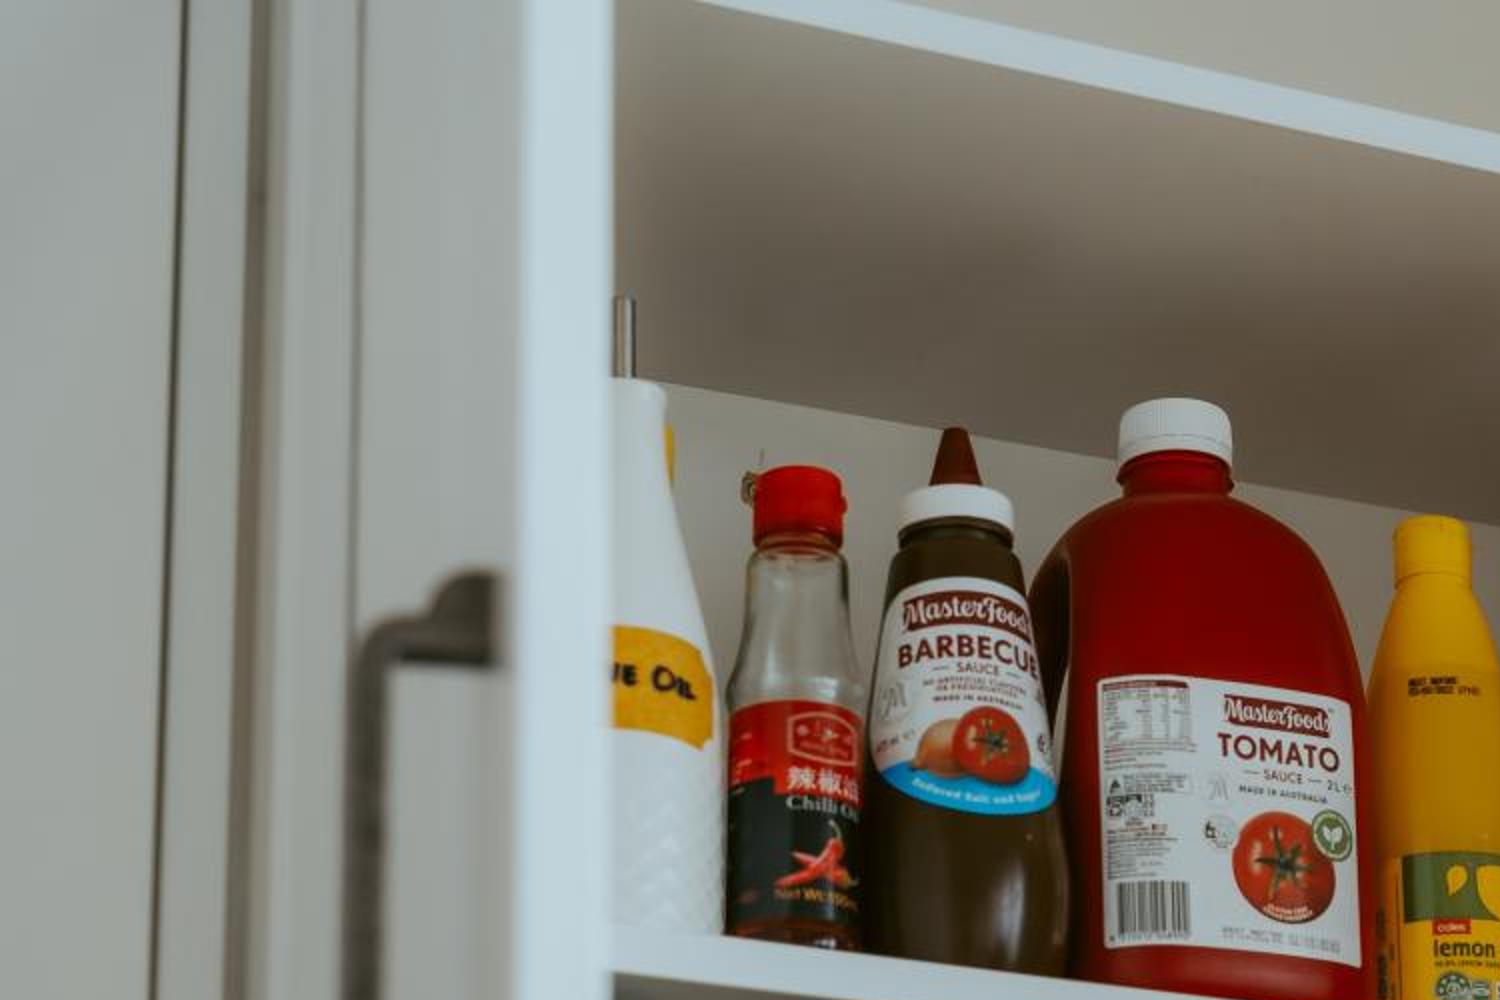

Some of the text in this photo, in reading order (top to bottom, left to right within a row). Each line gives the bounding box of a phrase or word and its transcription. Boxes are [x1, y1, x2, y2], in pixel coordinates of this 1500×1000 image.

[898, 634, 1038, 680] BARBECUE
[957, 661, 1000, 675] SAUCE
[1218, 732, 1340, 773] TOMATO
[1264, 769, 1303, 785] SAUCE
[1433, 939, 1496, 958] lemon
